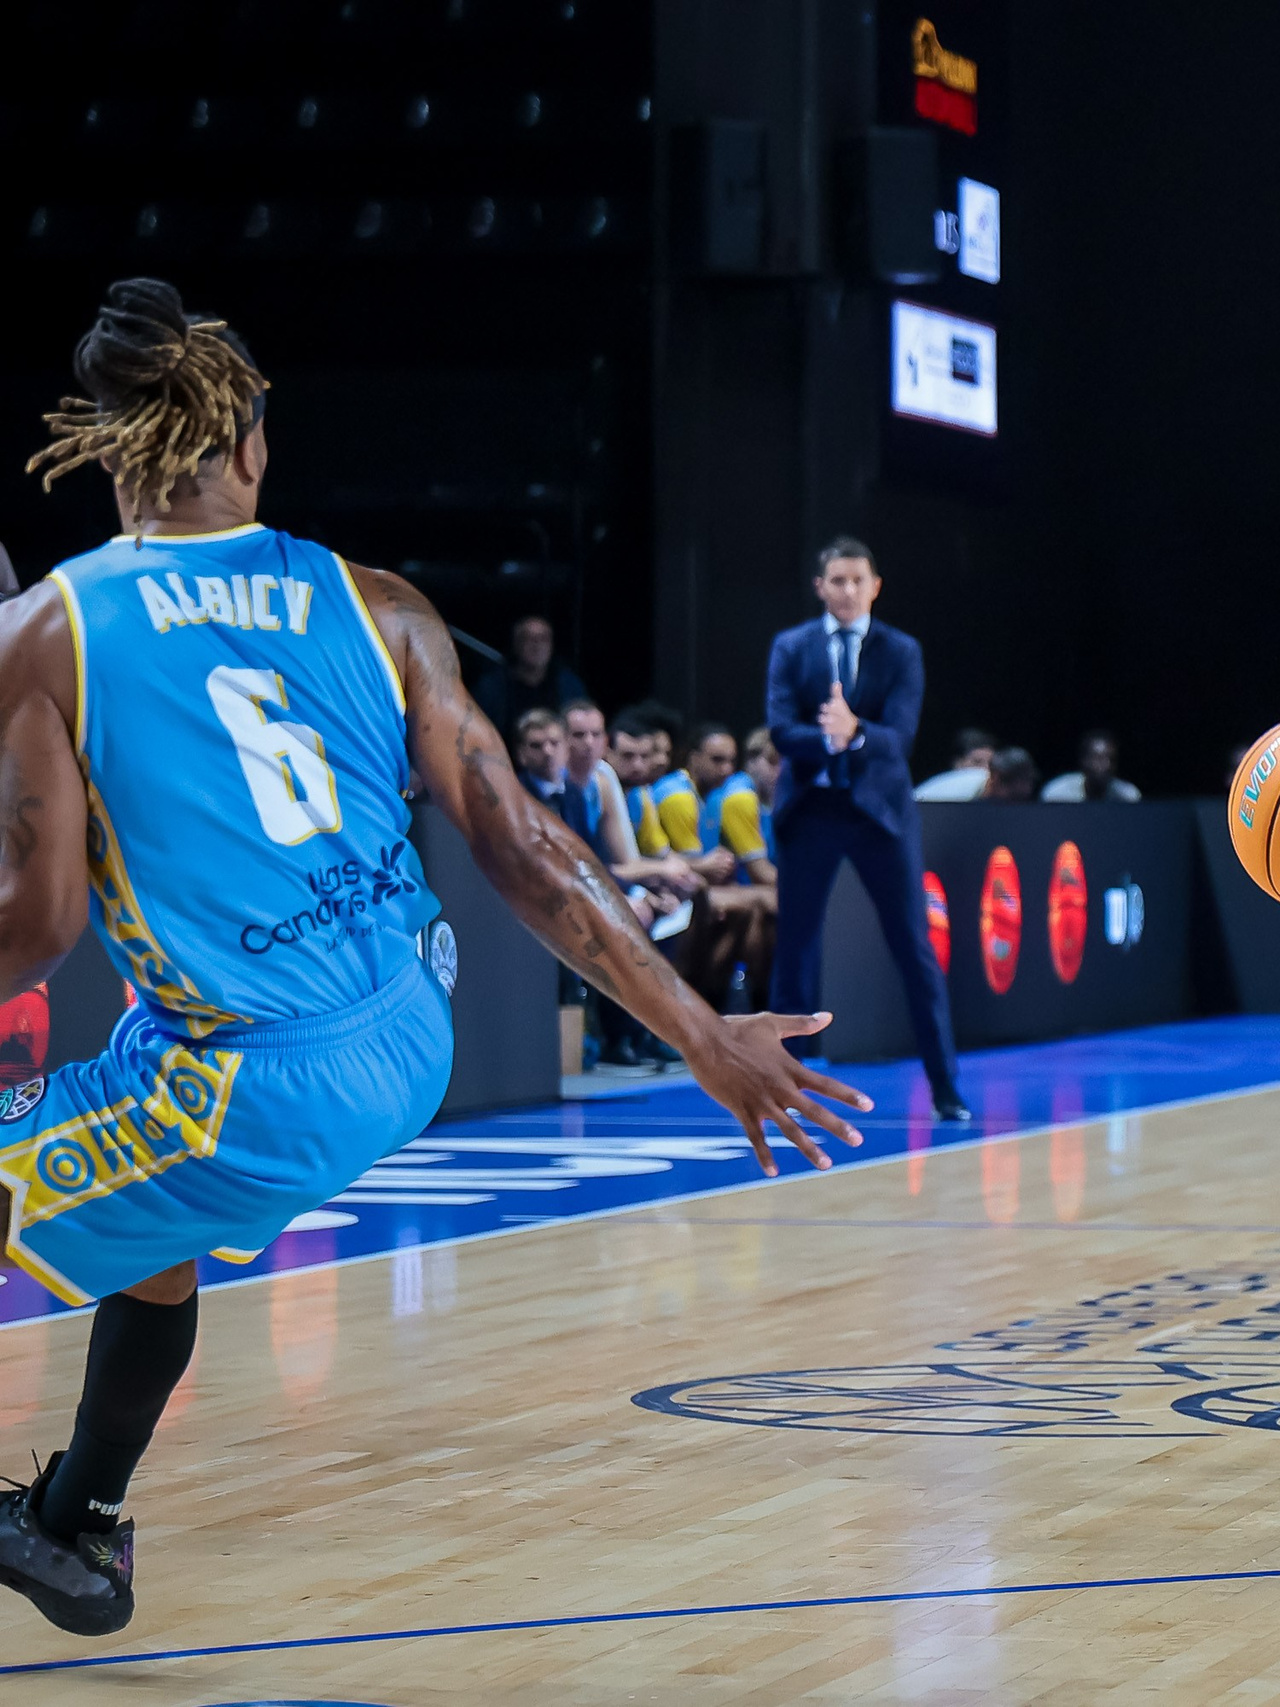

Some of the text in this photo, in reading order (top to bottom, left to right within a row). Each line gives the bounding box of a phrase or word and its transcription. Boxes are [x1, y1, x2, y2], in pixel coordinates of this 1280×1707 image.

[136, 572, 314, 635] ALBICY
[205, 665, 343, 847] 6
[1239, 748, 1277, 829] EVO
[88, 1499, 122, 1515] PUM
